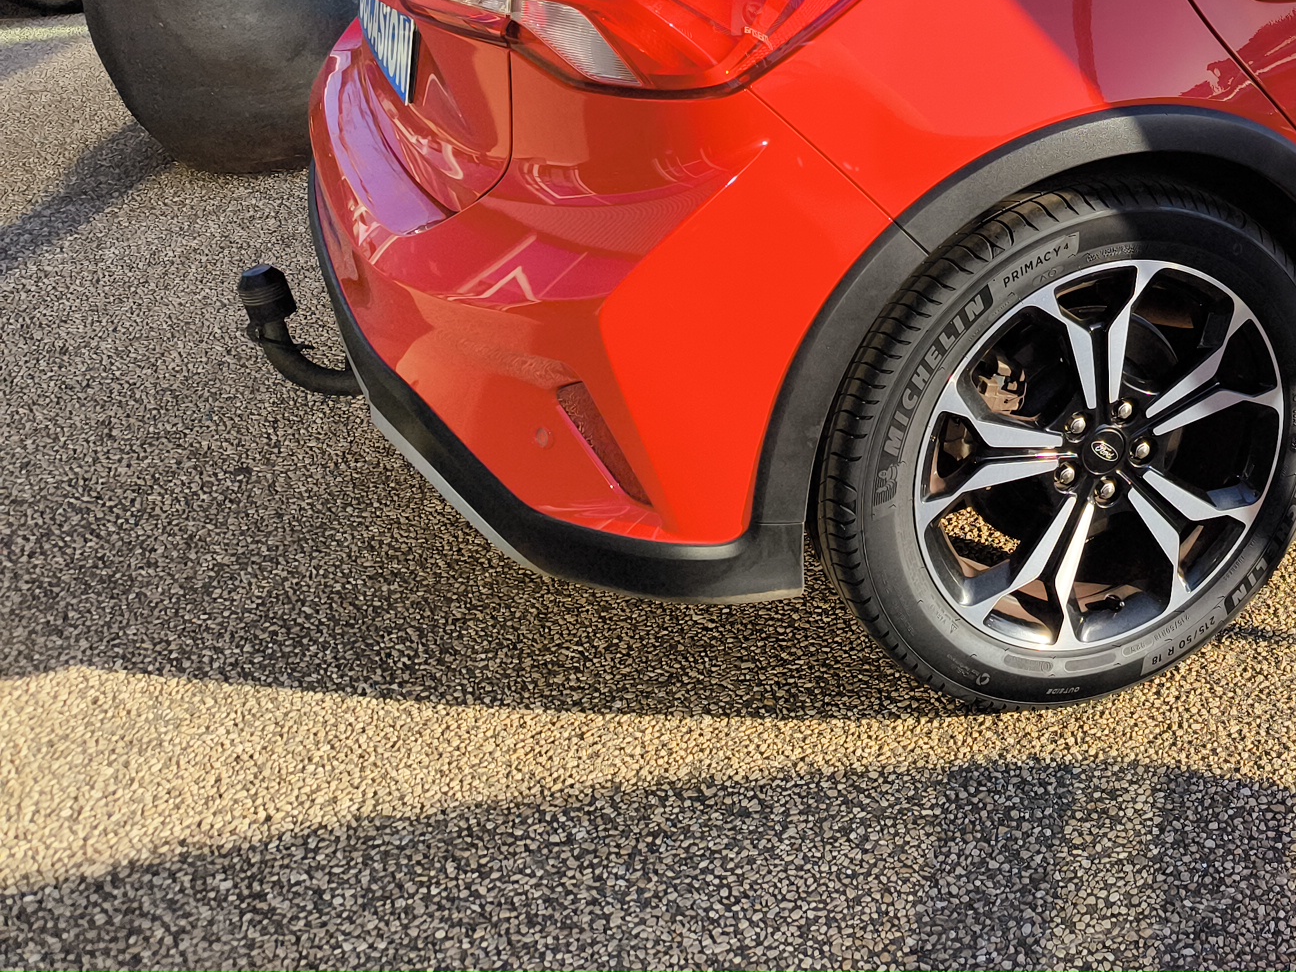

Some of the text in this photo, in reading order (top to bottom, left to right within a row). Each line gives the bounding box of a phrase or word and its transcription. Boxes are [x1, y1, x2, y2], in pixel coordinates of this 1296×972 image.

[1003, 245, 1062, 288] PRIMACY
[884, 293, 986, 457] MICHELIN
[1151, 615, 1216, 665] 215/50 R 18
[1046, 686, 1081, 695] OUTSIDE
